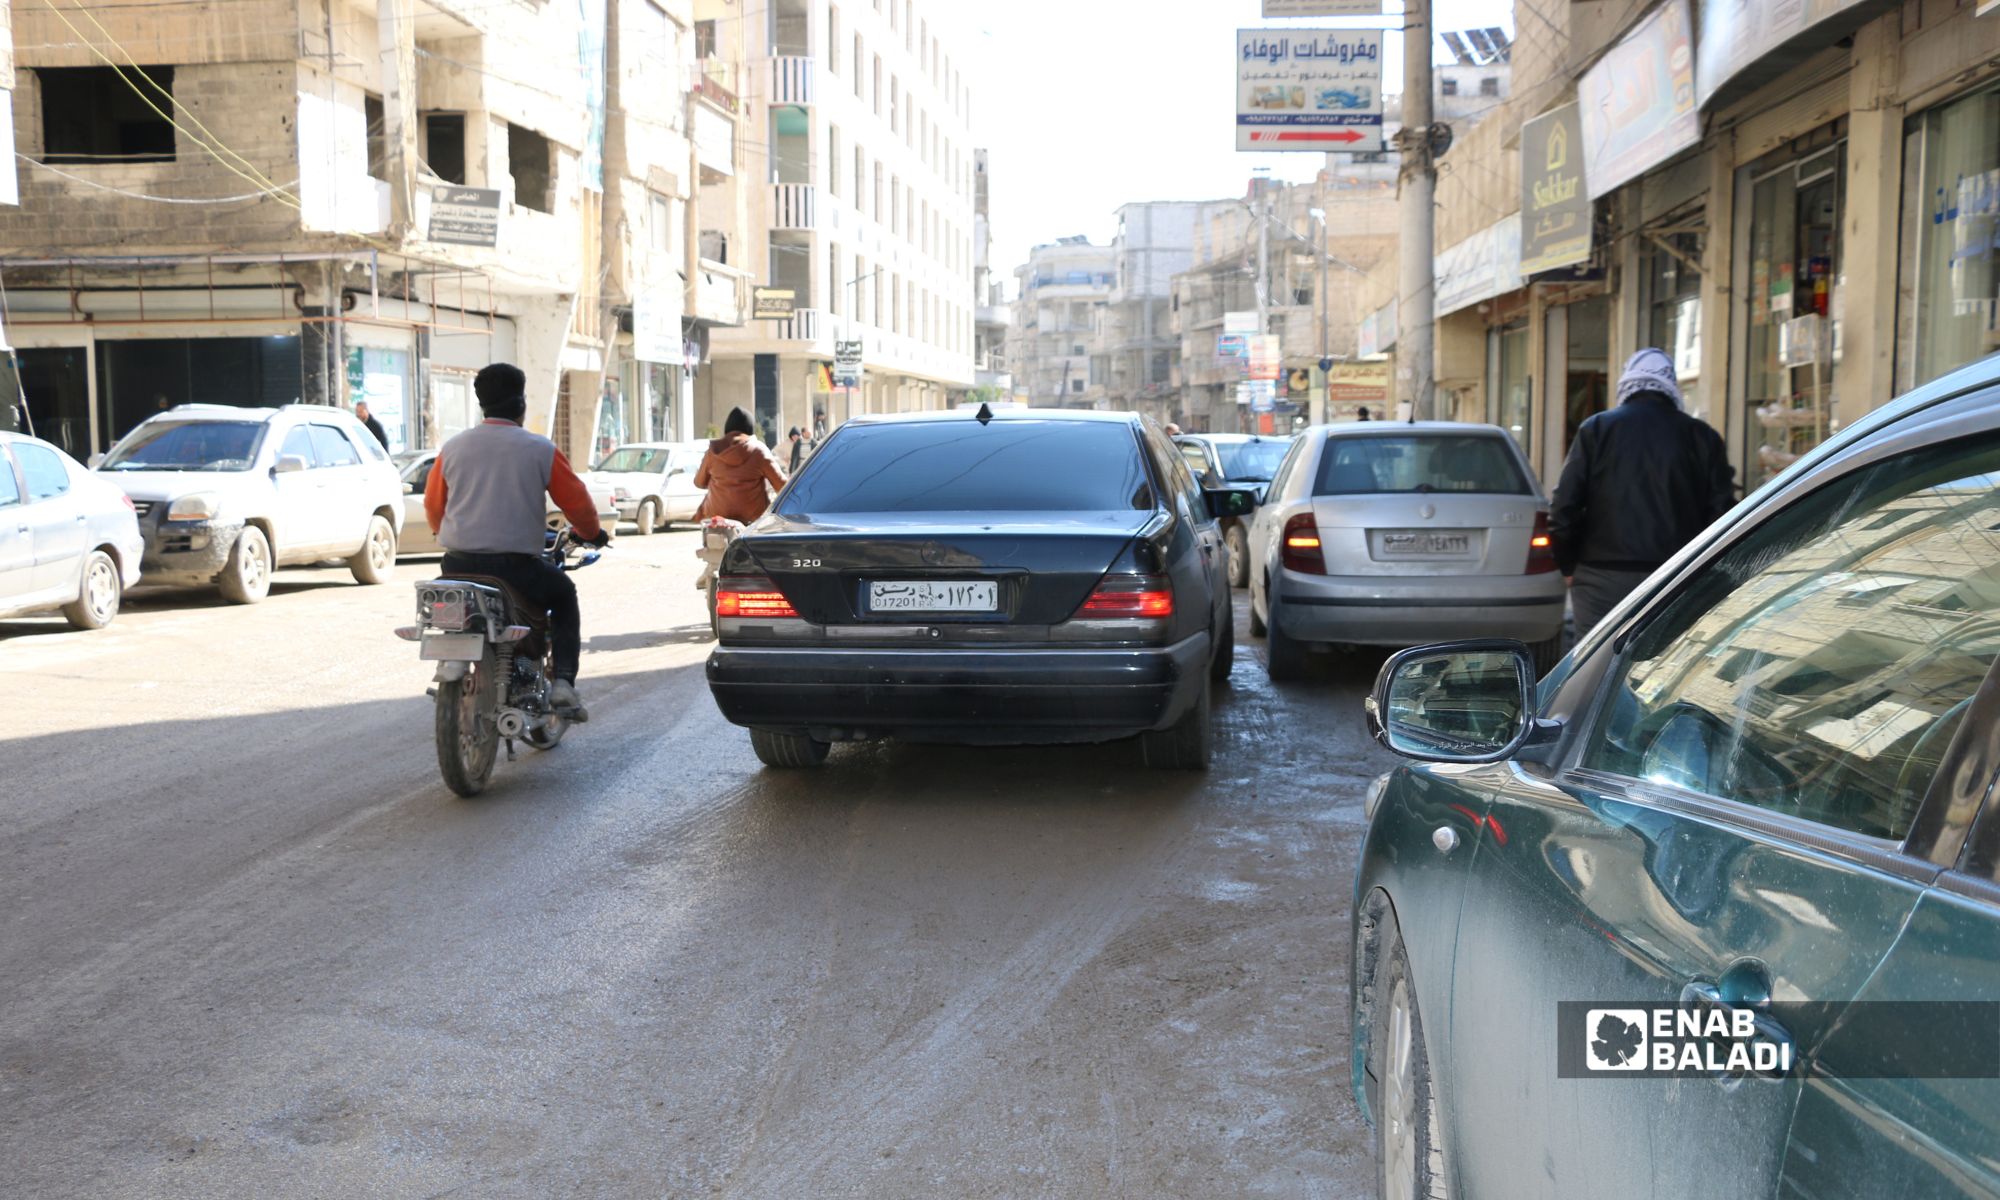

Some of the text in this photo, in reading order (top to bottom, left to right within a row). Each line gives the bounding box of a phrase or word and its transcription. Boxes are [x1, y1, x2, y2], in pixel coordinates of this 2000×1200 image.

[1242, 33, 1377, 63] مفروشات الوفاء
[453, 191, 480, 202] المحامي
[1532, 172, 1578, 210] Sukkar
[792, 558, 822, 568] 320
[874, 583, 916, 597] دمشق
[937, 584, 994, 607] ٠١٧٢٠١
[874, 598, 916, 608] 017201
